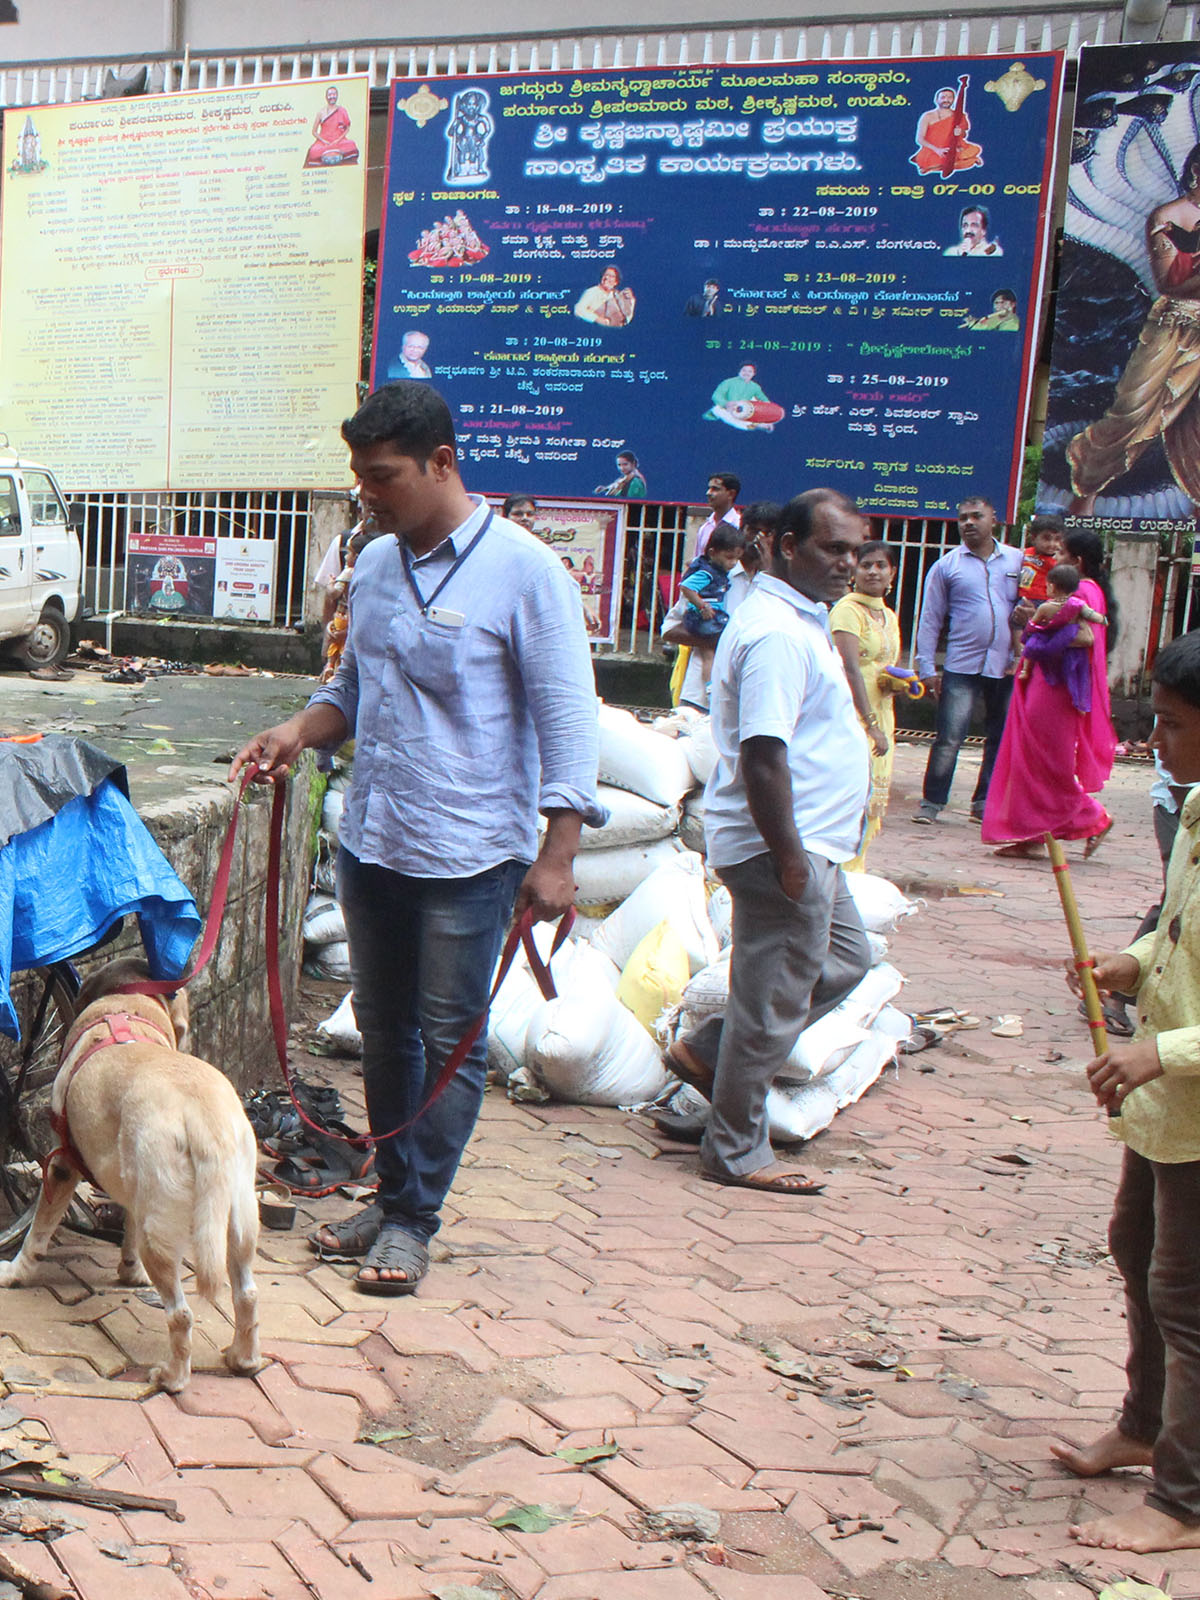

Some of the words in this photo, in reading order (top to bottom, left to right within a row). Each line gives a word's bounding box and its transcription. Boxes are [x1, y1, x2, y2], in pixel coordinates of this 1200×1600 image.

[500, 81, 564, 100] ಜಗದ್ಗುರು
[721, 73, 819, 87] ಮೂಲಮಹಾ
[828, 70, 911, 91] ಸಂಸ್ಥಾನಂ,
[503, 102, 584, 117] ಪರ್ಯಾಯ
[589, 100, 688, 118] ಶ್ರೀಪಲಿಮಾರು
[696, 97, 734, 111] ಮಠ,
[741, 94, 838, 116] ಶ್ರೀಕೃಷ್ಣಮಠ,
[847, 93, 912, 107] ಉಡುಪಿ.
[533, 123, 568, 148] ಶ್ರೀ
[763, 116, 858, 143] ಪ್ರಯುಕ್ತ
[525, 154, 647, 183] ಸಾಂಸ್ಕೃತಿಕ
[659, 152, 863, 178] ಕಾರ್ಯಕ್ರಮಗಳು.
[816, 185, 870, 196] ಸಮಯ
[890, 184, 926, 200] ರಾತ್ರಿ
[932, 184, 995, 196] 07-00
[1002, 183, 1042, 195] ರಿಂದ
[392, 191, 415, 206] ಸ್ಥಳ
[505, 205, 520, 214] ತಾ
[536, 203, 613, 214] 18-08-2019
[758, 208, 775, 216] ತಾ
[792, 206, 878, 217] 22-08-2019
[561, 235, 589, 248] ಮತ್ತು
[570, 250, 616, 259] ಇವರಿಂದ
[430, 274, 444, 284] ತಾ
[459, 274, 532, 284] 19-08-2019
[783, 274, 799, 282] ತಾ
[816, 272, 896, 283] 23-08-2019
[746, 304, 760, 317] ಶ್ರೀ
[871, 306, 886, 319] ಶ್ರೀ
[505, 338, 520, 346] ತಾ
[533, 336, 602, 347] 20-08-2019
[706, 340, 721, 350] ತಾ
[739, 340, 822, 352] 24-08-2019
[489, 366, 502, 378] ಶ್ರೀ
[610, 370, 635, 382] ಮತ್ತು
[826, 374, 844, 384] ತಾ
[862, 374, 948, 387] 25-08-2019
[544, 382, 584, 392] ಇವರಿಂದ
[460, 404, 474, 414] ತಾ
[490, 404, 564, 416] 21-08-2019
[792, 404, 807, 418] ಶ್ರೀ
[848, 421, 878, 436] ಮತ್ತು
[476, 434, 502, 447] ಮತ್ತು
[534, 451, 578, 462] ಇವರಿಂದ
[872, 460, 909, 476] ಸ್ವಾಗತ
